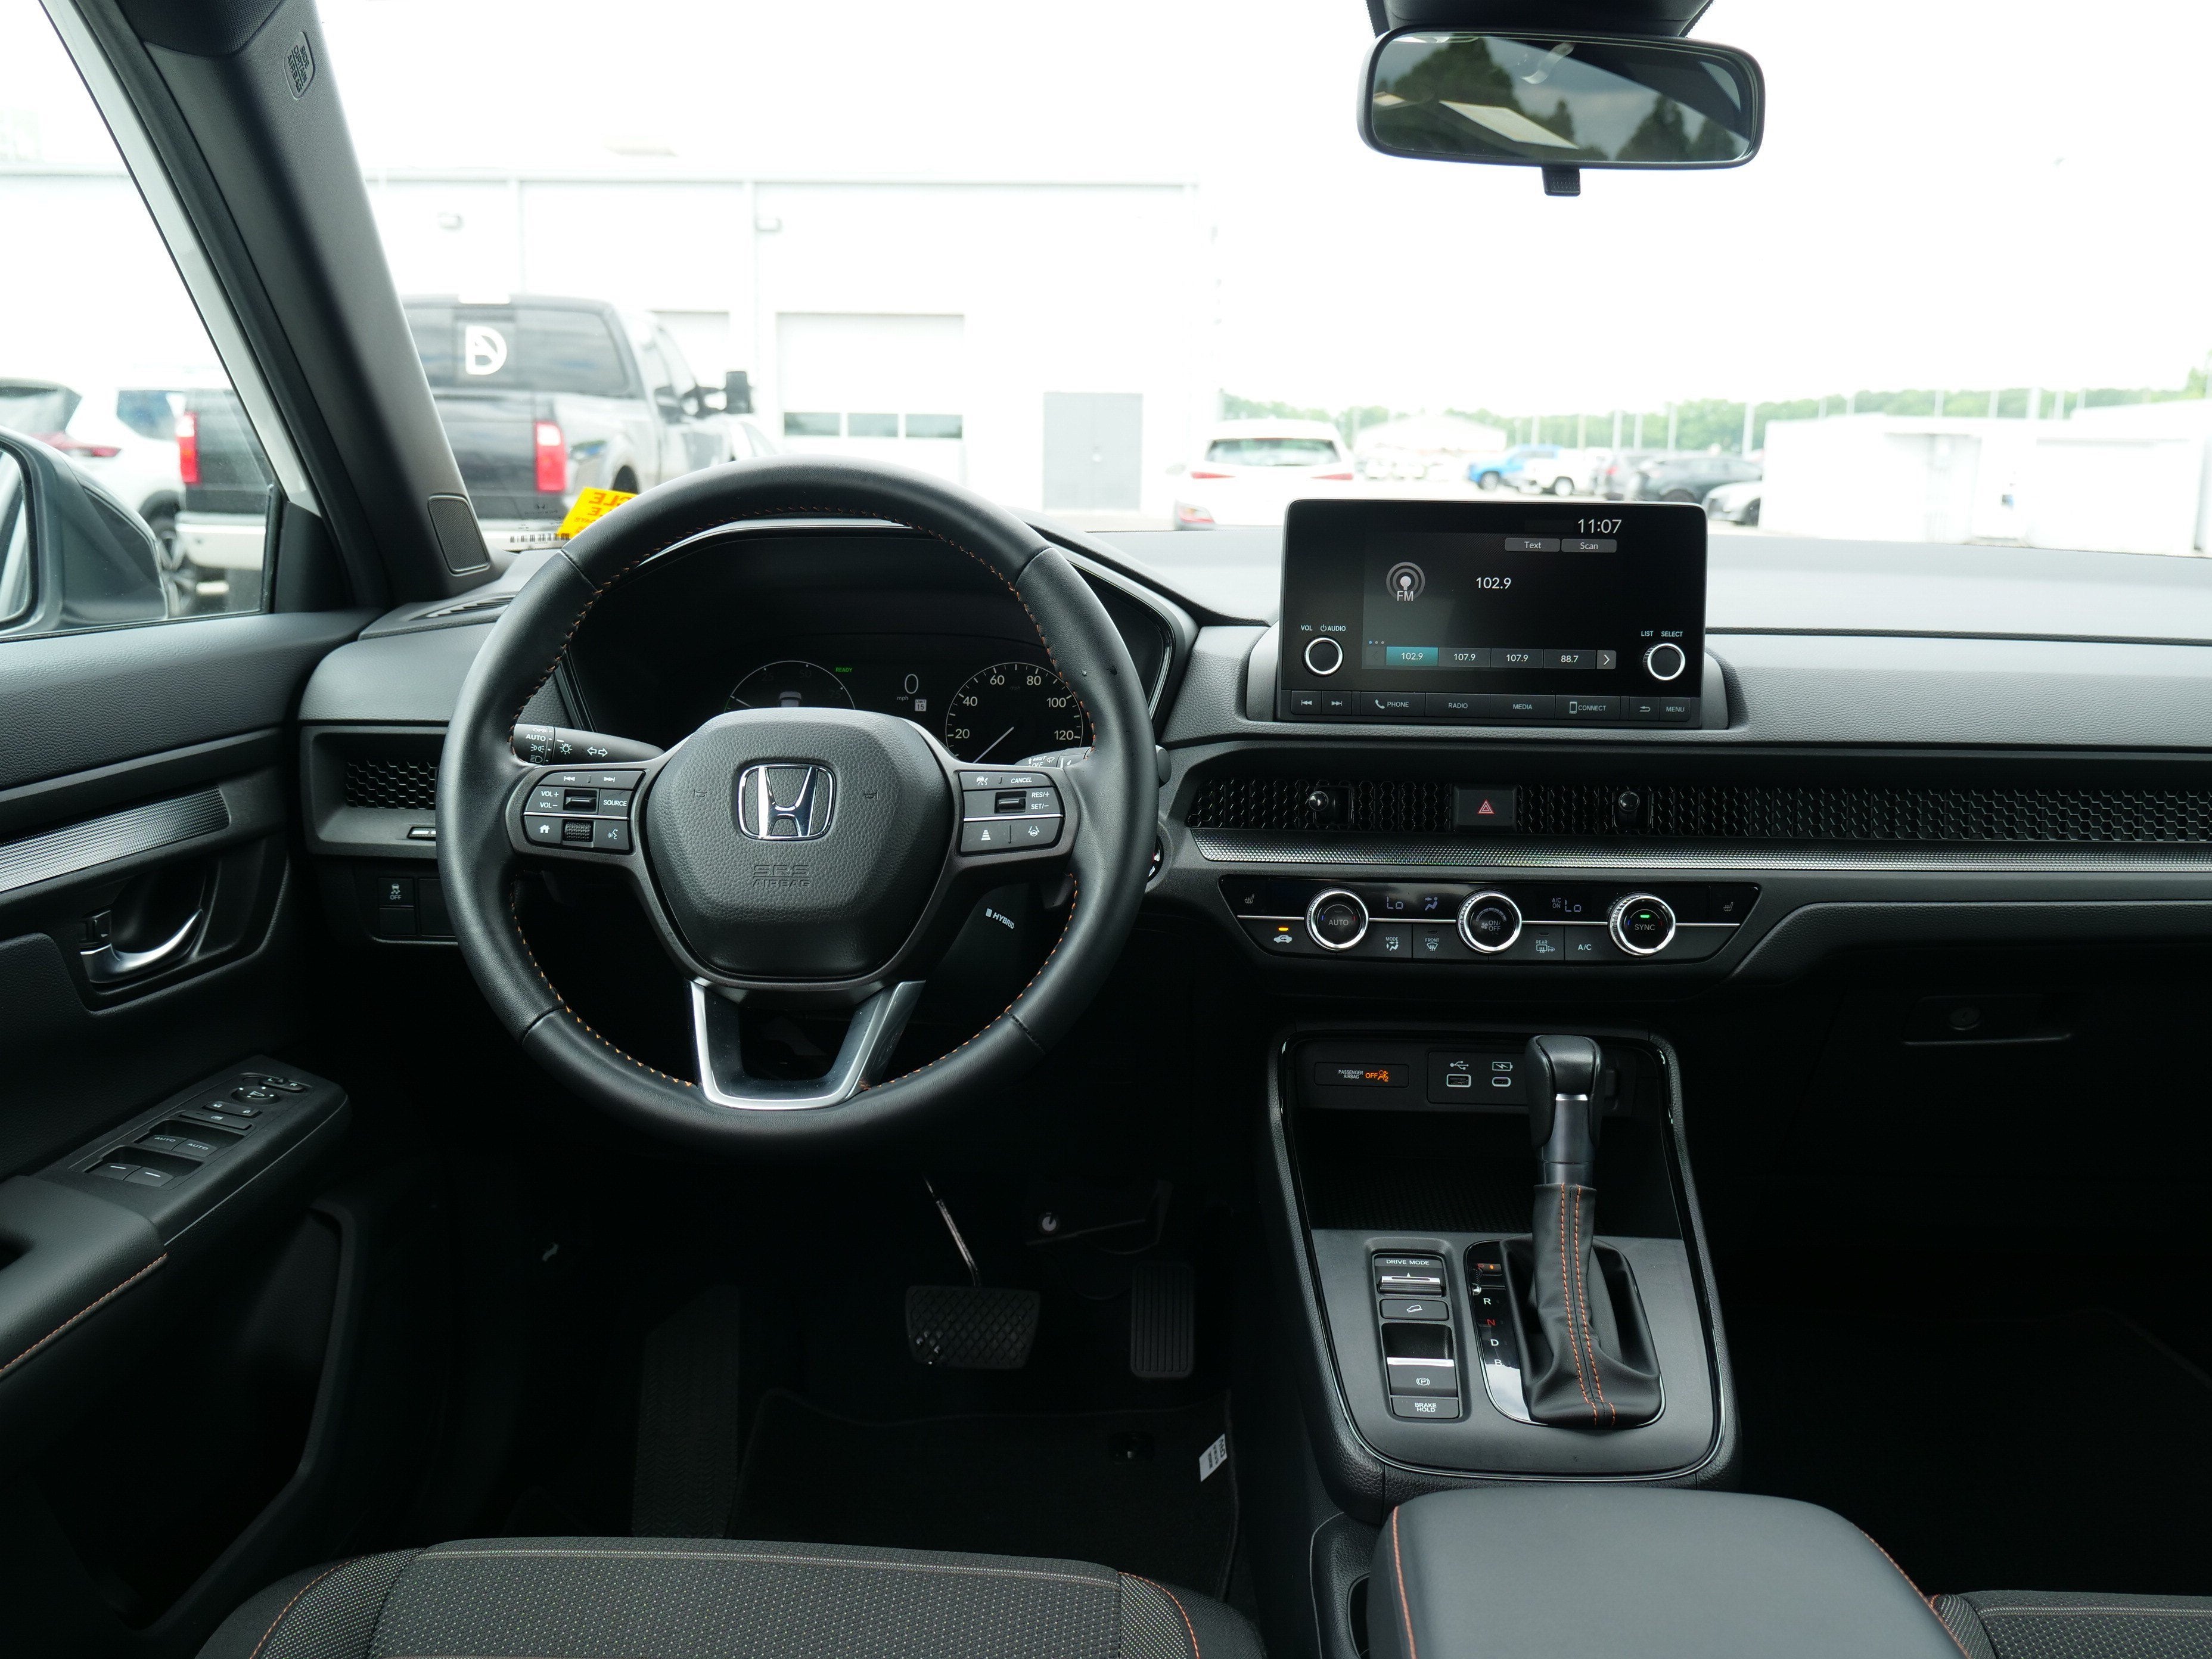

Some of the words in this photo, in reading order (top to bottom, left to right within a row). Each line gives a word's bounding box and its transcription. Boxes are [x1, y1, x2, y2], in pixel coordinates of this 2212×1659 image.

[300, 45, 310, 69] SIDE
[293, 45, 307, 83] CURTAIN
[287, 55, 302, 93] AIRBAG
[1577, 518, 1622, 535] 11:07
[1524, 541, 1542, 549] Text
[1579, 542, 1599, 551] Scan
[1475, 576, 1512, 590] 102.9
[1396, 590, 1415, 602] FM
[1401, 652, 1424, 661] 102.9
[1453, 653, 1476, 662] 107.9
[1506, 654, 1528, 663] 107.9
[1561, 654, 1579, 663] 88.7
[904, 673, 919, 694] 0
[990, 675, 1005, 685] 60
[1026, 675, 1042, 686] 80
[962, 696, 978, 707] 40
[1046, 697, 1067, 708] 100
[1577, 704, 1607, 712] CONNECT
[955, 728, 970, 739] 20
[1054, 730, 1074, 740] 120
[752, 864, 810, 877] SRS
[752, 878, 811, 889] AIRBAG
[1386, 896, 1403, 909] Lo
[1564, 899, 1582, 912] Lo
[992, 912, 1015, 930] HYBRID
